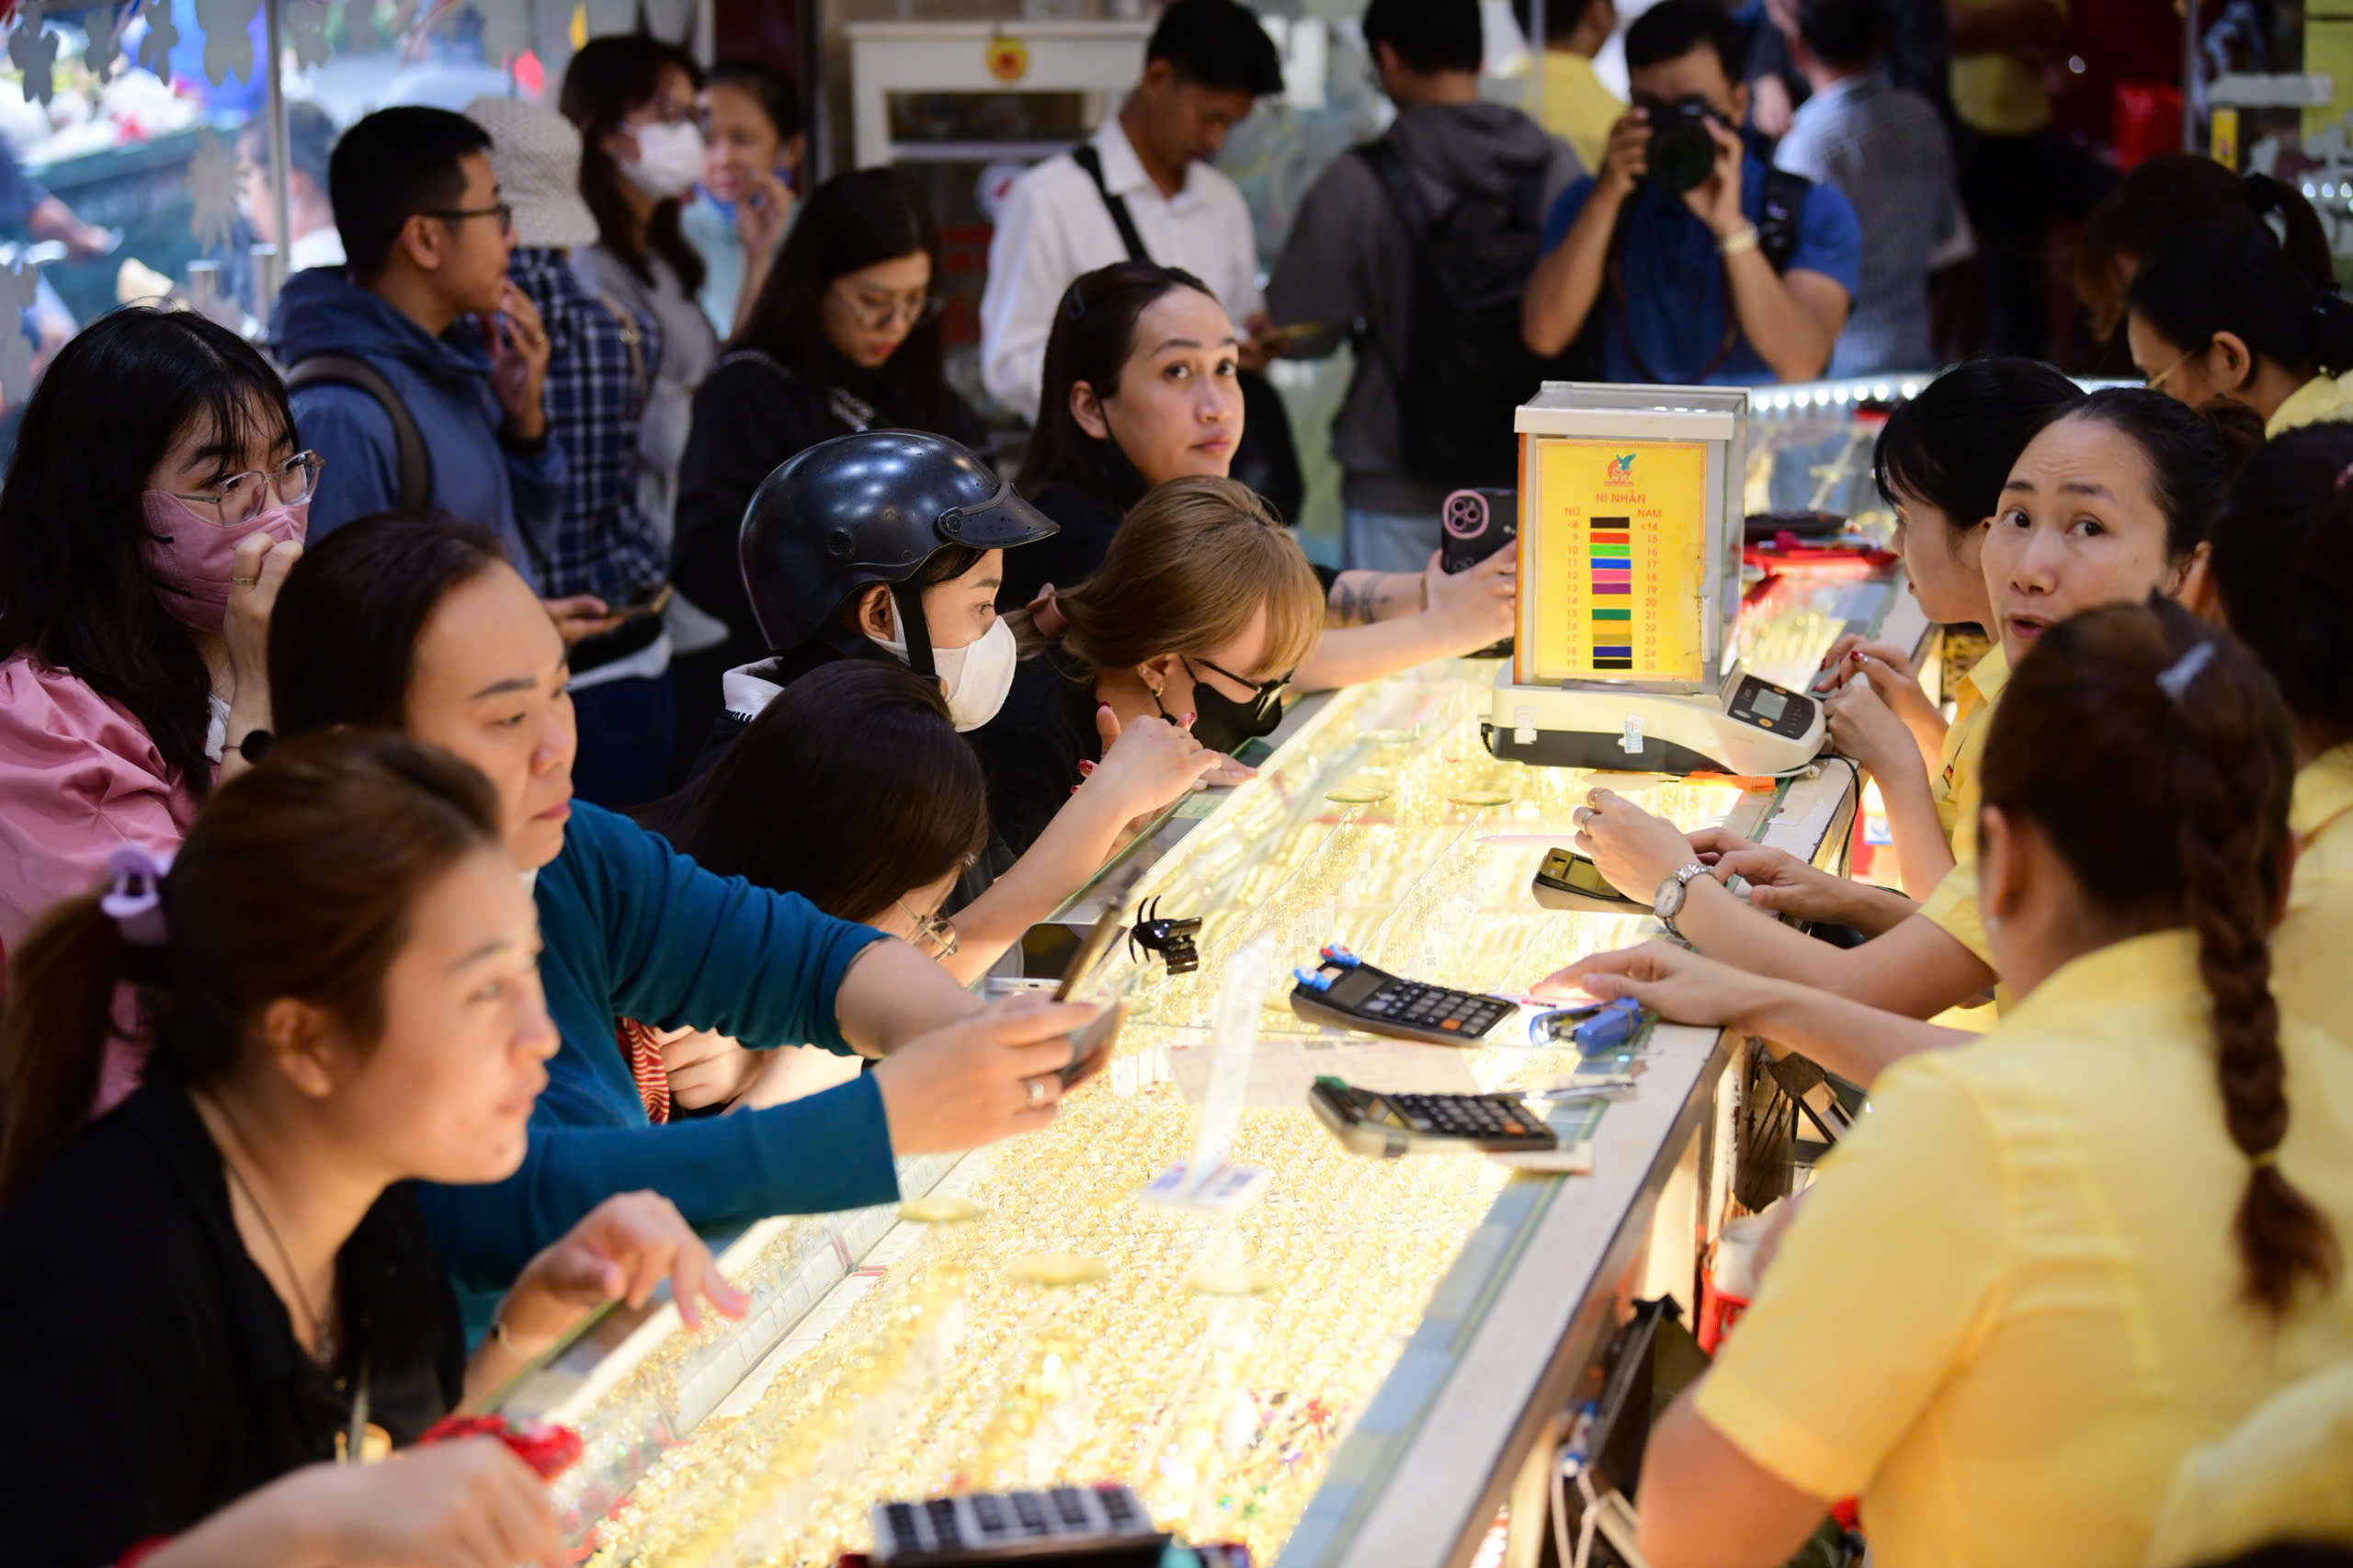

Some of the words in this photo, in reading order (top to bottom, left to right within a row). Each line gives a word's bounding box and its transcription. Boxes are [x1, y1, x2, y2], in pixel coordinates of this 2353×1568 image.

[1596, 492, 1608, 504] NI
[1637, 508, 1662, 518] NAM
[1647, 534, 1658, 544] 15
[1567, 545, 1579, 554] 10
[1647, 547, 1658, 556] 16
[1567, 558, 1578, 567] 11
[1647, 559, 1658, 569] 17
[1567, 570, 1578, 580] 12
[1645, 597, 1658, 608] 20
